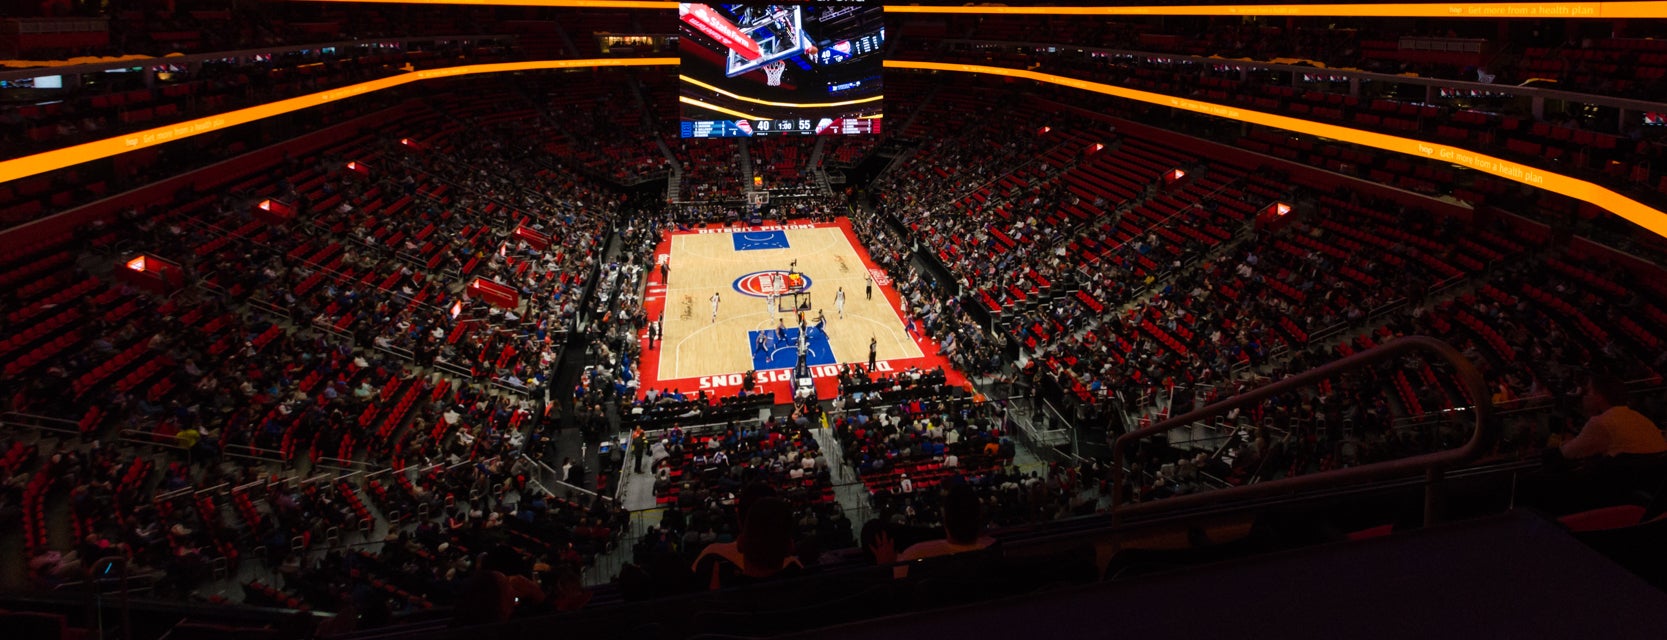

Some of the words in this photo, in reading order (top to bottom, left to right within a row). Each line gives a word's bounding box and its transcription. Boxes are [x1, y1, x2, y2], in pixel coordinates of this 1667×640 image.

[1468, 6, 1482, 15] Get
[1484, 7, 1505, 15] more
[1507, 6, 1528, 15] from
[1539, 6, 1569, 15] health
[1571, 6, 1594, 16] plan
[757, 120, 770, 131] 40
[778, 122, 792, 130] 1:00
[798, 119, 811, 130] 55
[1418, 144, 1434, 156] hop
[1440, 148, 1454, 160] Get
[1456, 153, 1474, 164] more
[1475, 157, 1491, 169] from
[1500, 163, 1523, 178] health
[1525, 171, 1543, 184] plan
[699, 369, 791, 389] PISONS
